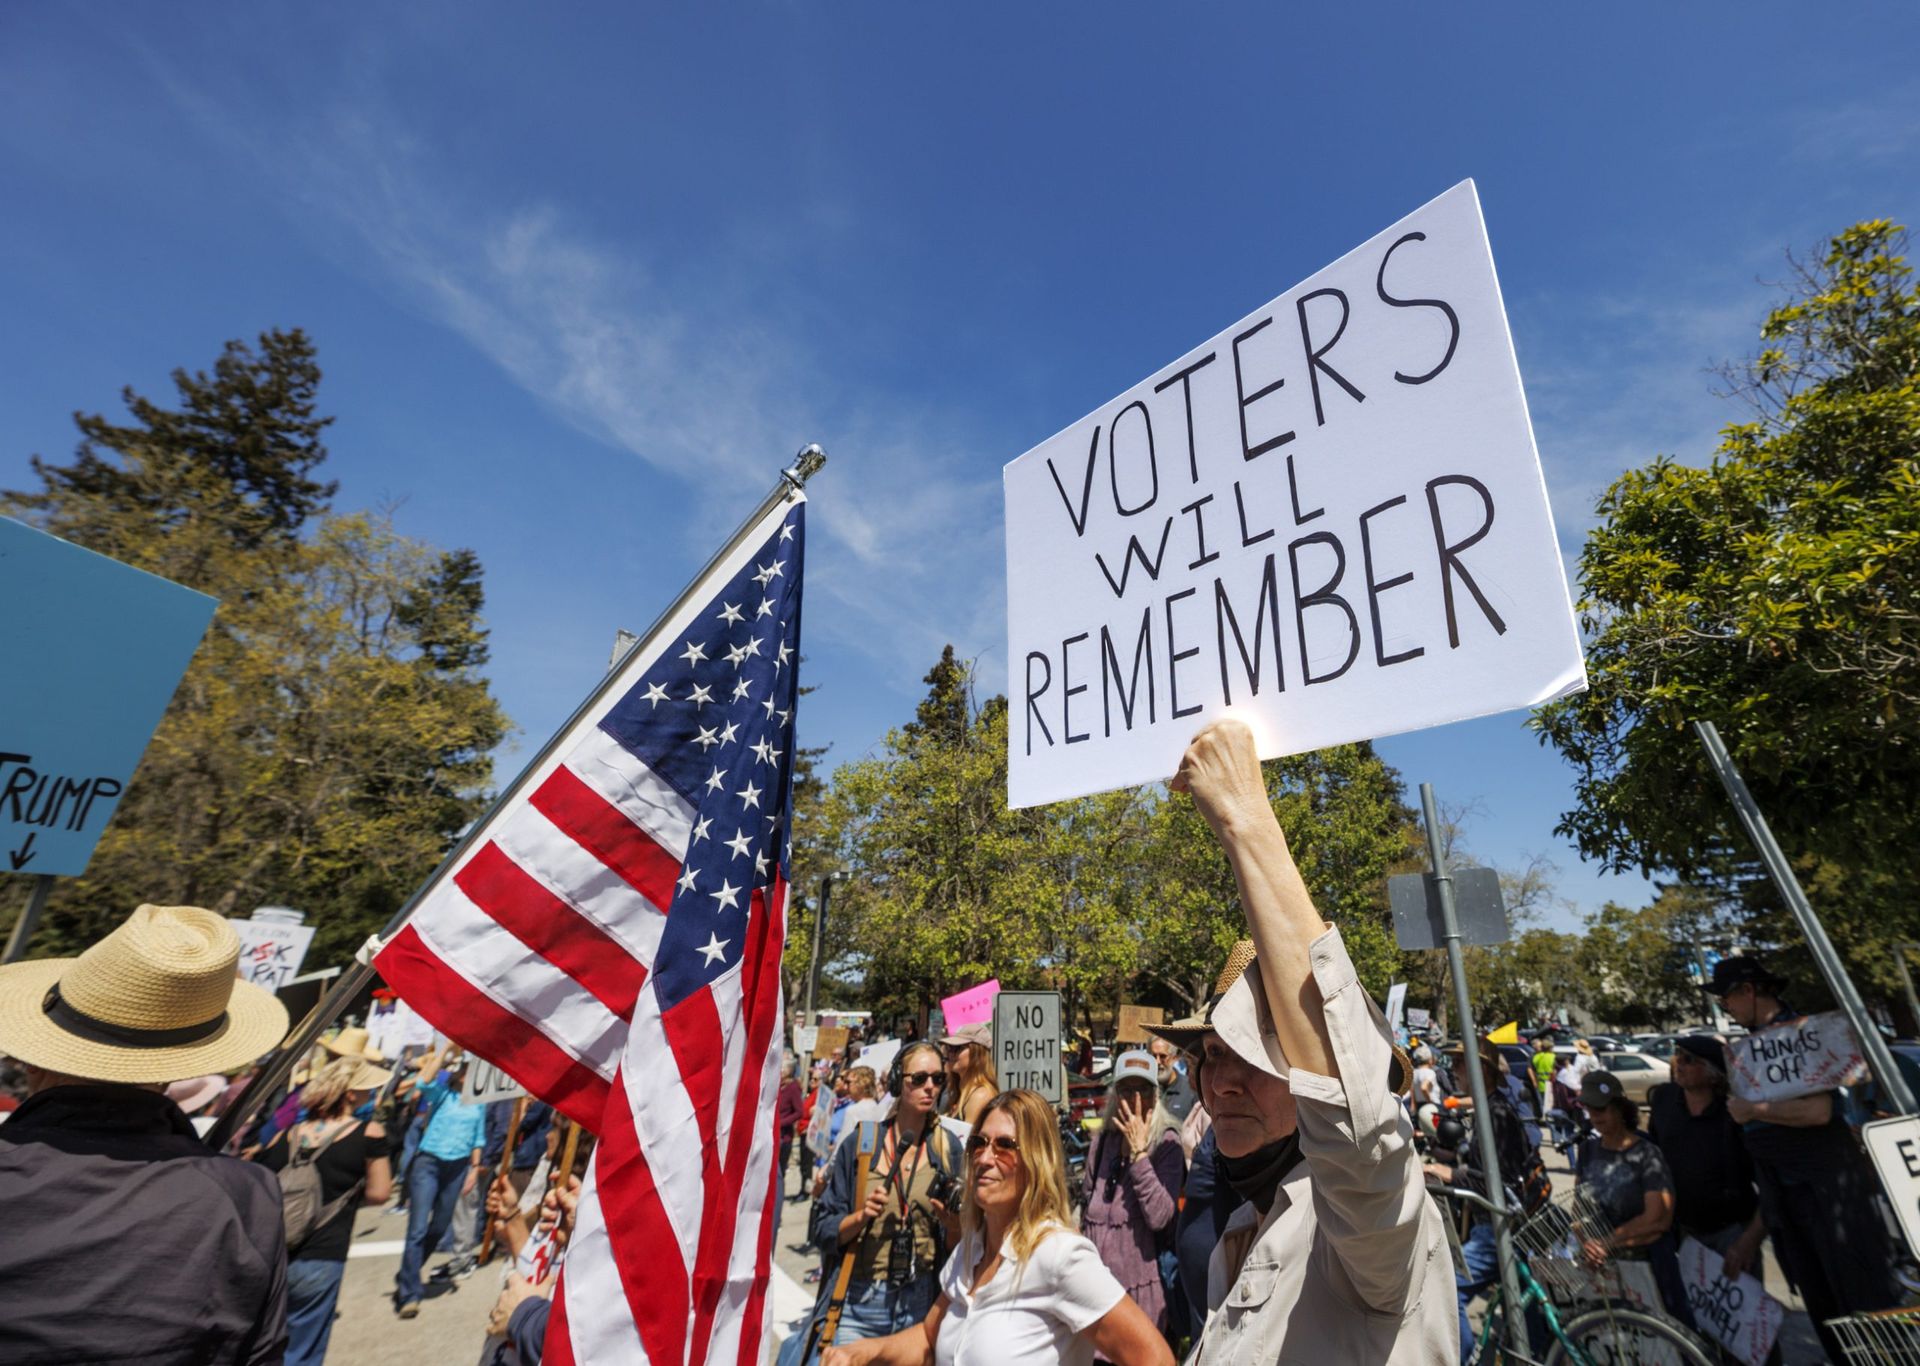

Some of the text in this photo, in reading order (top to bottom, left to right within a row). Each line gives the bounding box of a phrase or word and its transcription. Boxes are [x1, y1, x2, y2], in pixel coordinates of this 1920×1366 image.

[1046, 231, 1461, 537] VOTERS
[1094, 454, 1326, 599] WILL
[1025, 474, 1508, 757] REMEMBER
[1004, 1039, 1055, 1061] RIGHT
[1016, 1005, 1044, 1029] NO
[1005, 1069, 1053, 1091] TURN
